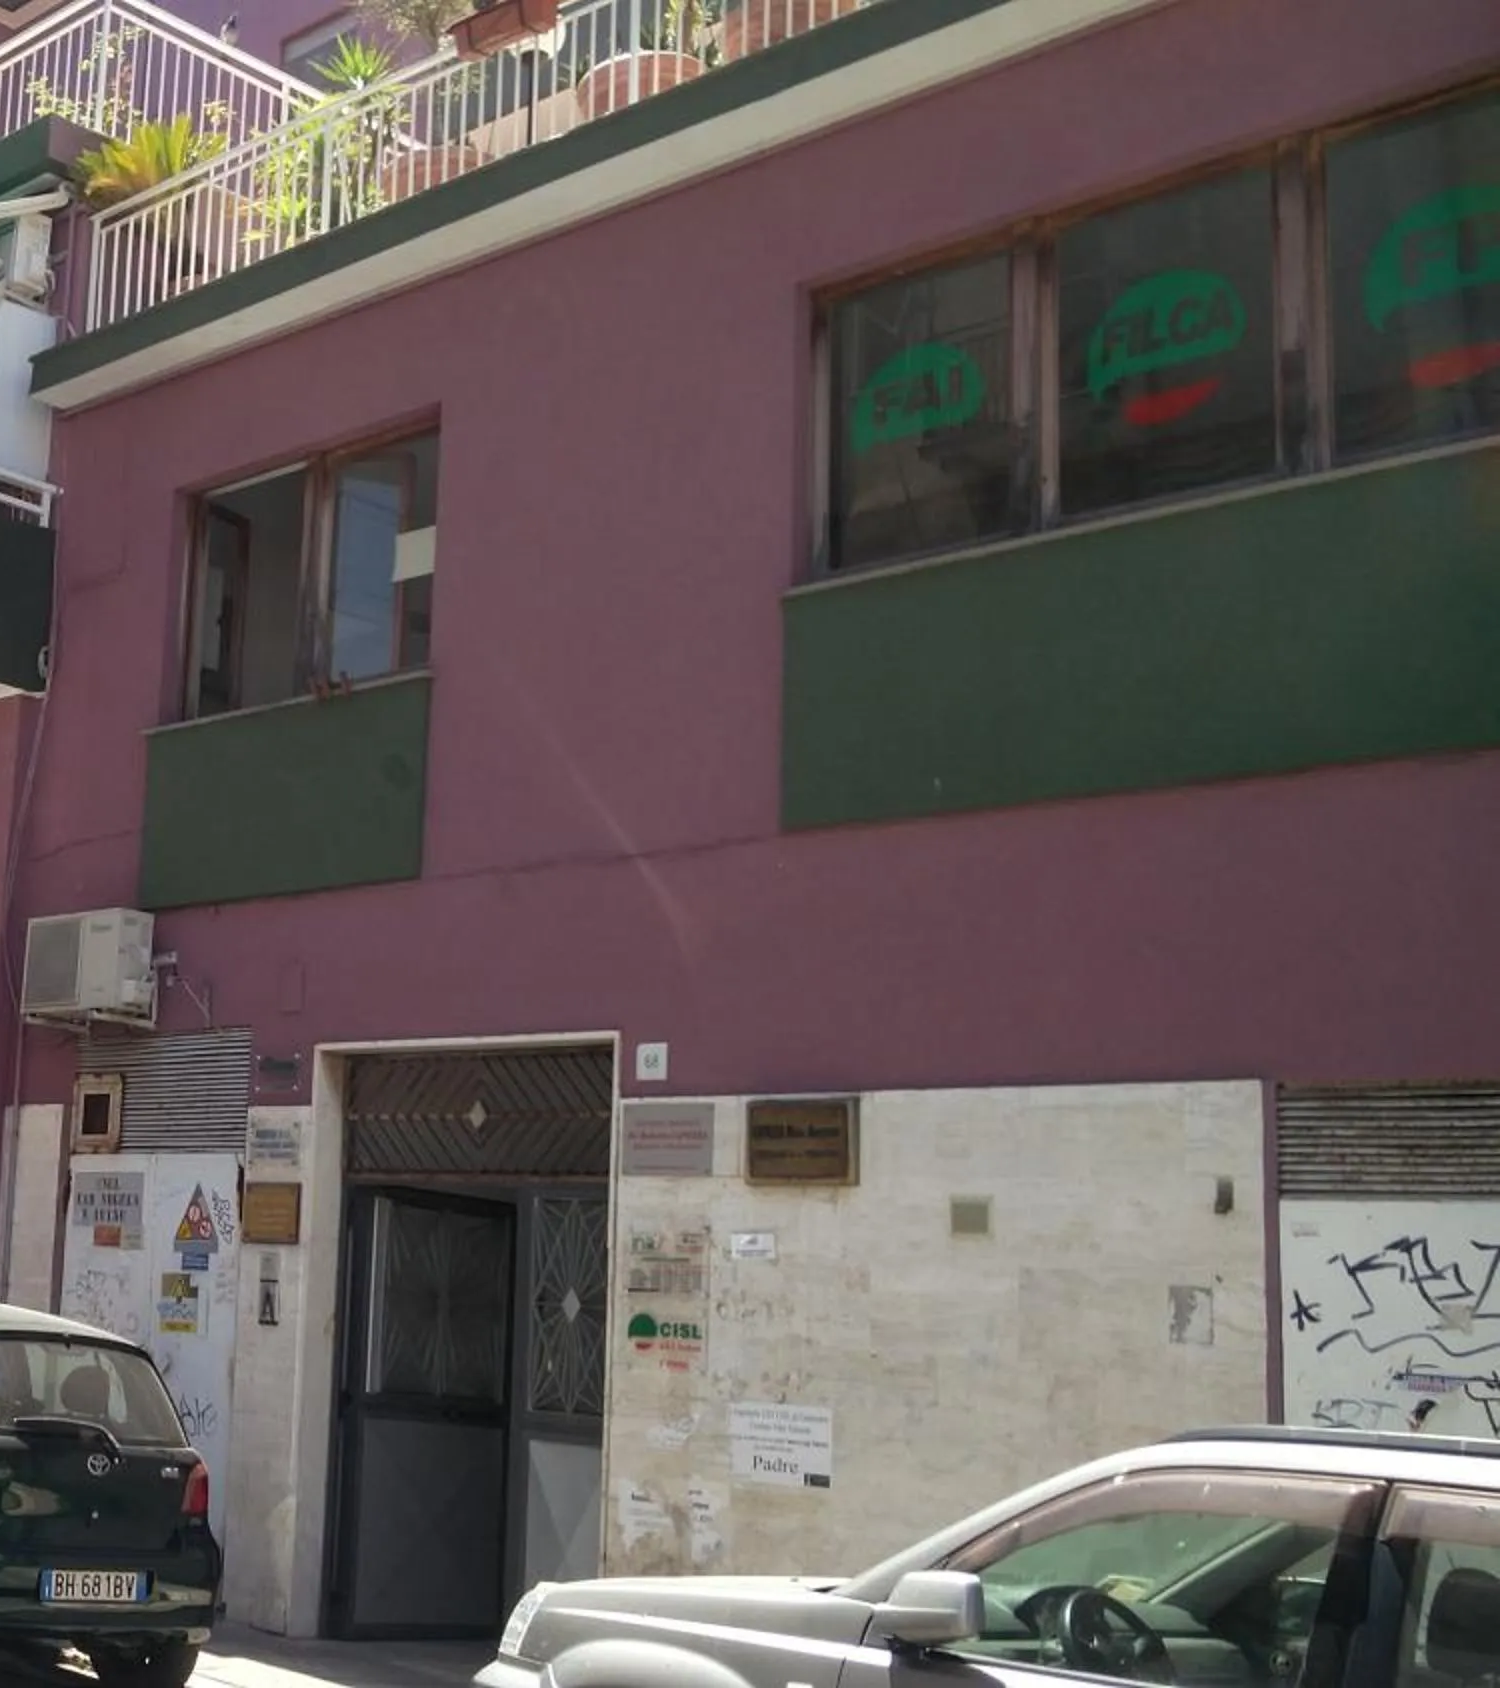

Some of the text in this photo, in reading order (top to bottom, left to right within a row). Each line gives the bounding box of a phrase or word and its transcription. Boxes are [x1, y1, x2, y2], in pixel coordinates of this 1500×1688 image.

[872, 362, 963, 427] FAI
[660, 1321, 702, 1339] CISL
[753, 1455, 799, 1475] Padre
[54, 1573, 135, 1599] BH 681BV
